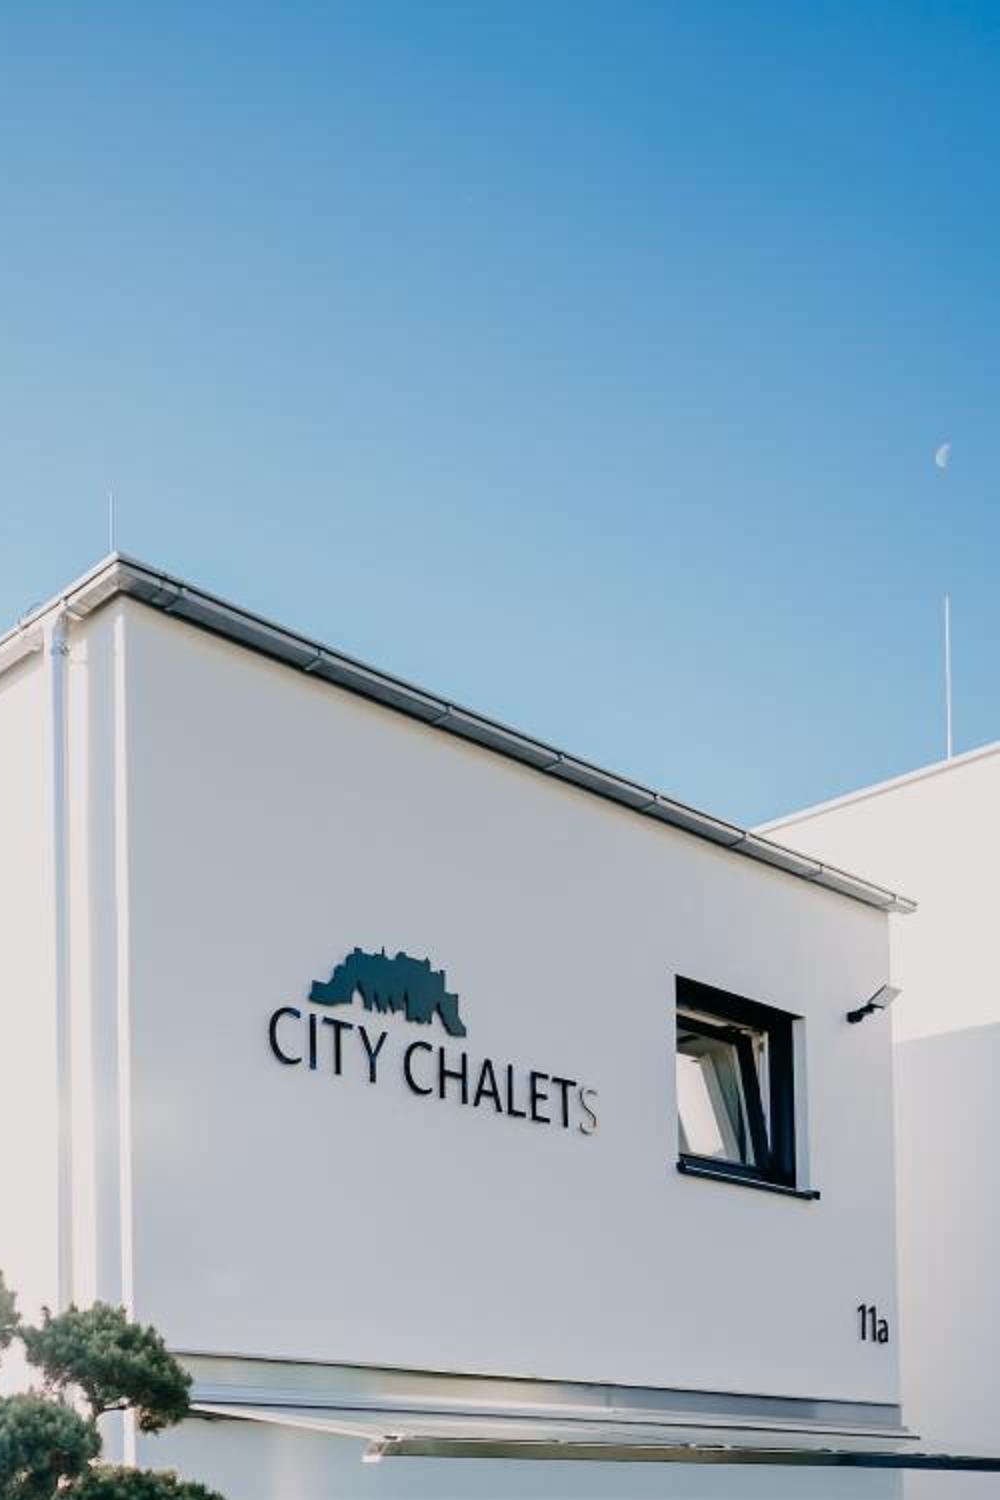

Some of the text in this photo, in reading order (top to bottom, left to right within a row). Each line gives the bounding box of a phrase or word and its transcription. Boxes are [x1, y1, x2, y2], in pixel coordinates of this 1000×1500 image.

[269, 1007, 598, 1135] CITY CHALETS
[857, 1303, 889, 1344] 11a
